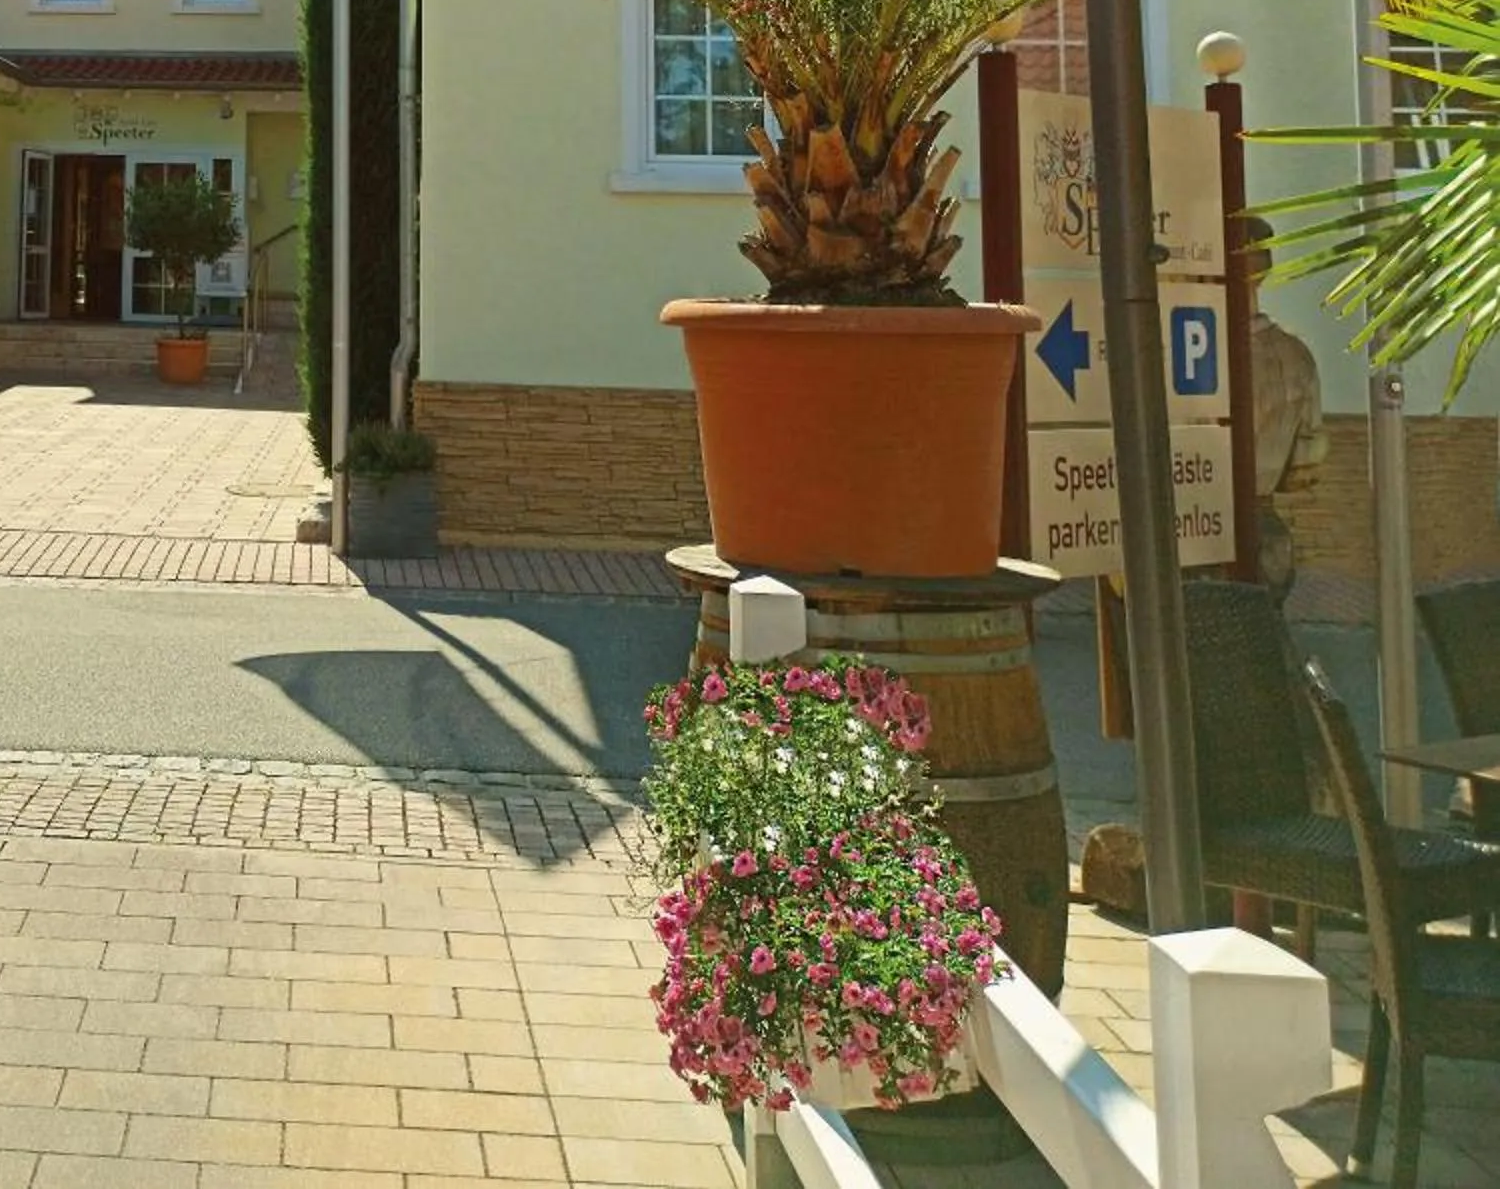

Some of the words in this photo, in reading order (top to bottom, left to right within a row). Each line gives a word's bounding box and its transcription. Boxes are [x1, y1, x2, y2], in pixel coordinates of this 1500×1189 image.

[1184, 320, 1208, 379] P
[1054, 456, 1115, 501] Speet
[1172, 452, 1213, 485] äste
